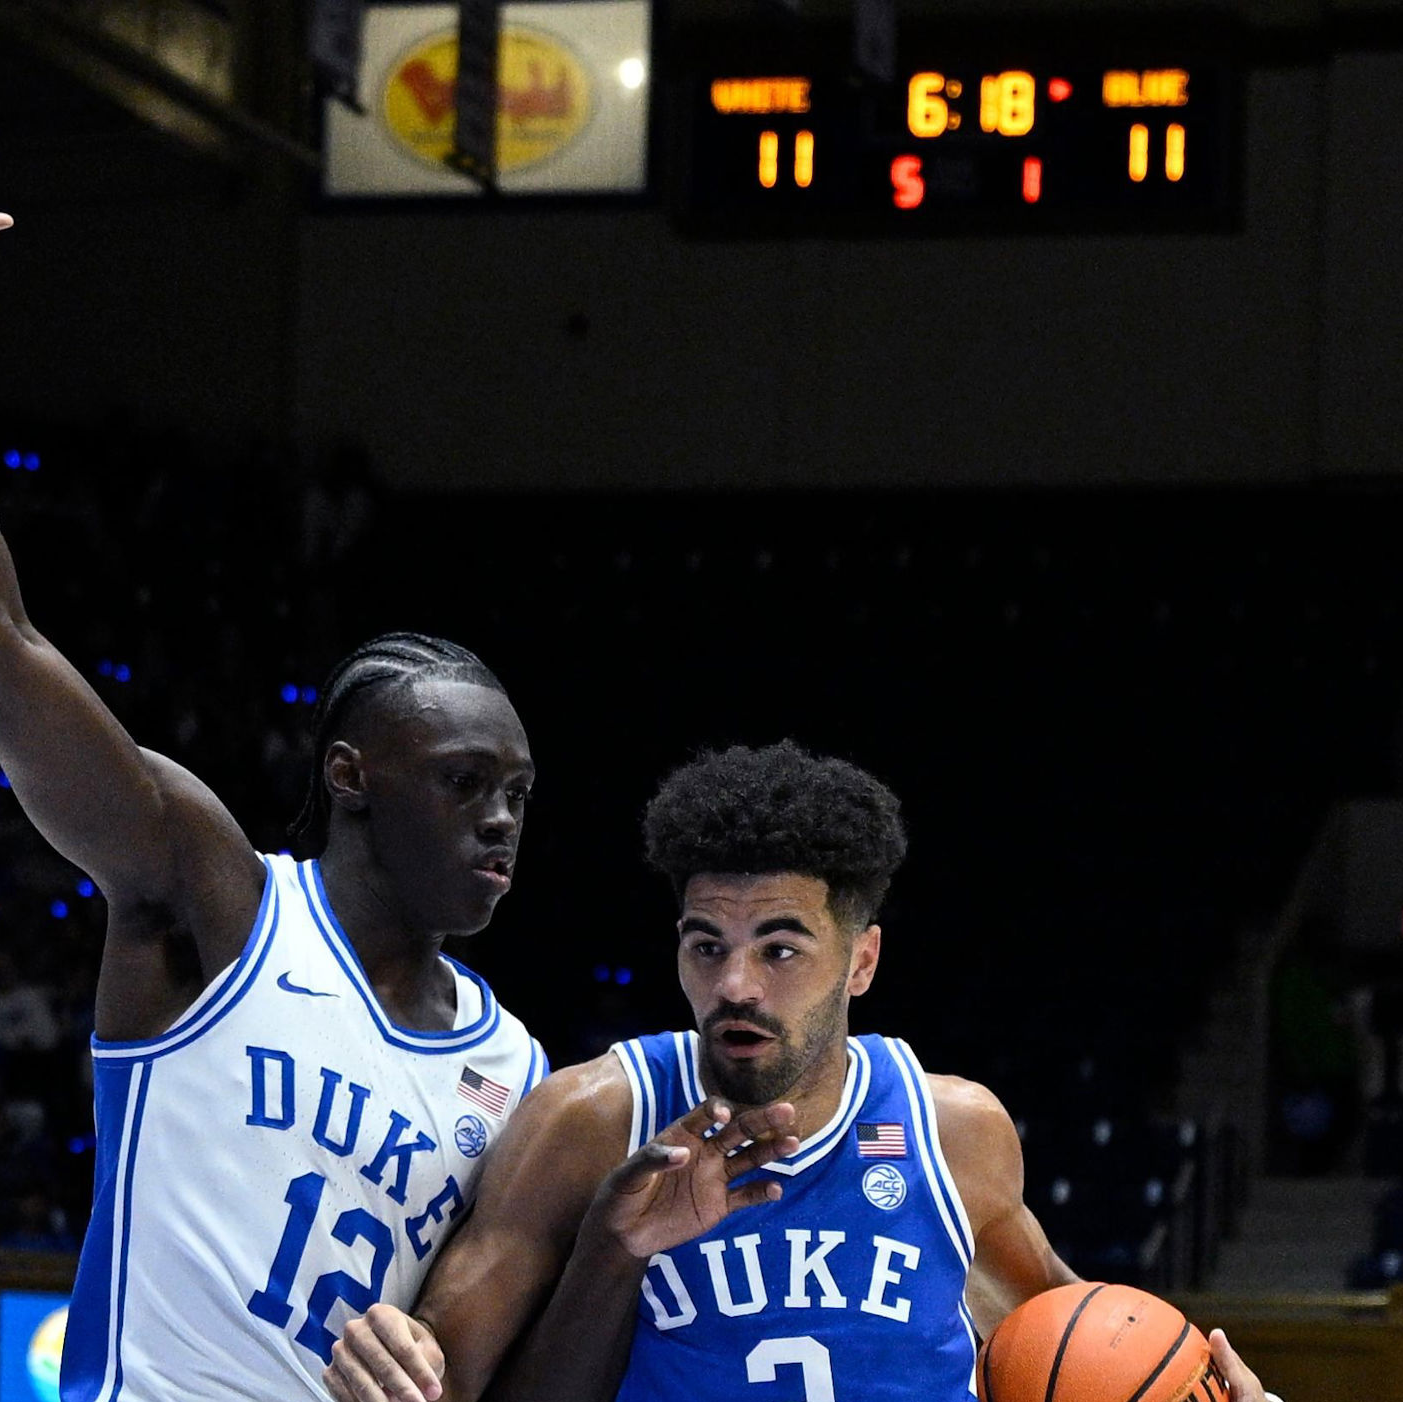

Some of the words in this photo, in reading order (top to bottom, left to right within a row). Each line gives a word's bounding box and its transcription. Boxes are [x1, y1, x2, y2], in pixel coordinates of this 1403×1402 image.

[908, 71, 1035, 137] 6:18
[759, 130, 814, 188] 11
[1129, 123, 1185, 182] 11
[244, 1045, 465, 1262] DUKE
[248, 1171, 395, 1366] 12
[641, 1228, 921, 1331] DUKE
